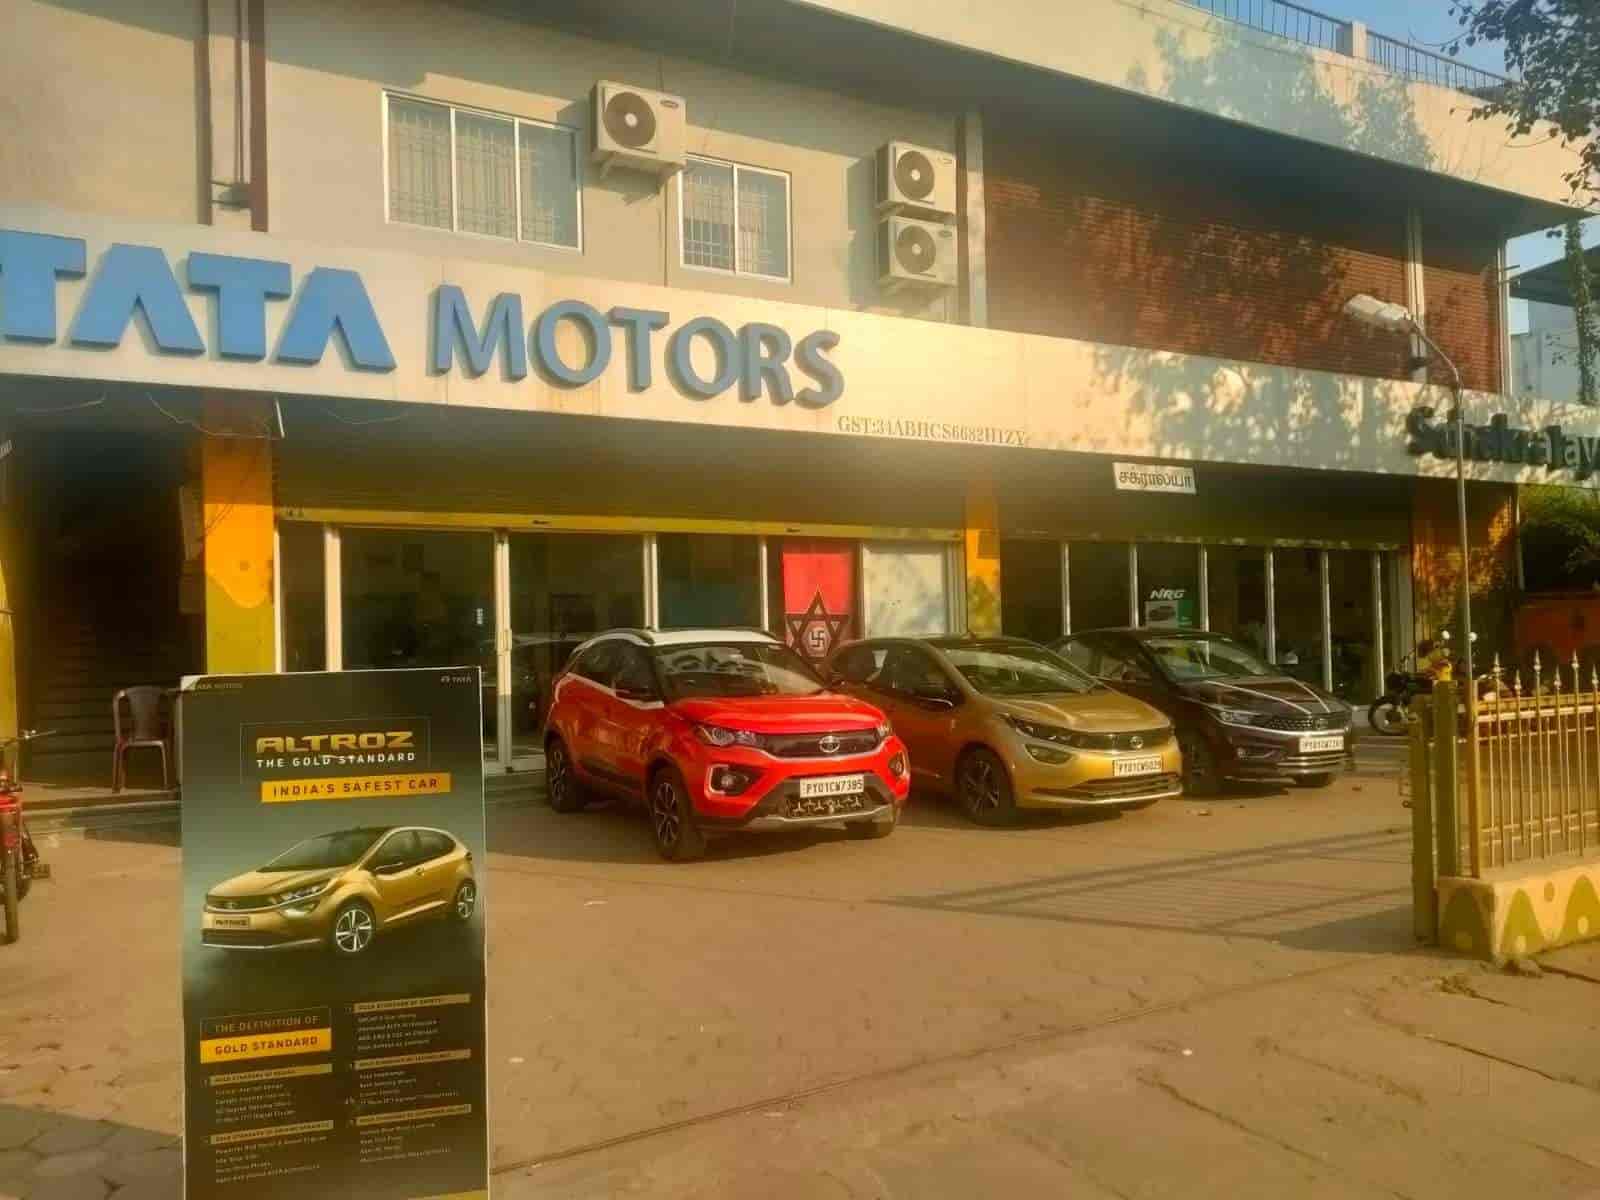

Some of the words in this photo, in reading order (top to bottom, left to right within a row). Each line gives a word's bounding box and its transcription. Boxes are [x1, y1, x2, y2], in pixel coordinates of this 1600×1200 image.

[0, 230, 397, 373] TATA
[427, 284, 845, 409] MOTORS
[1150, 588, 1186, 600] NRG
[256, 731, 415, 754] ALTROZ
[257, 758, 285, 768] THE
[292, 756, 331, 767] GOLD
[339, 752, 416, 764] STANDARD
[273, 783, 335, 797] INDIA'S
[343, 780, 402, 792] SAFEST
[408, 777, 438, 789] CAR
[215, 1043, 248, 1055] GOLD
[252, 1036, 318, 1051] STANDARD
